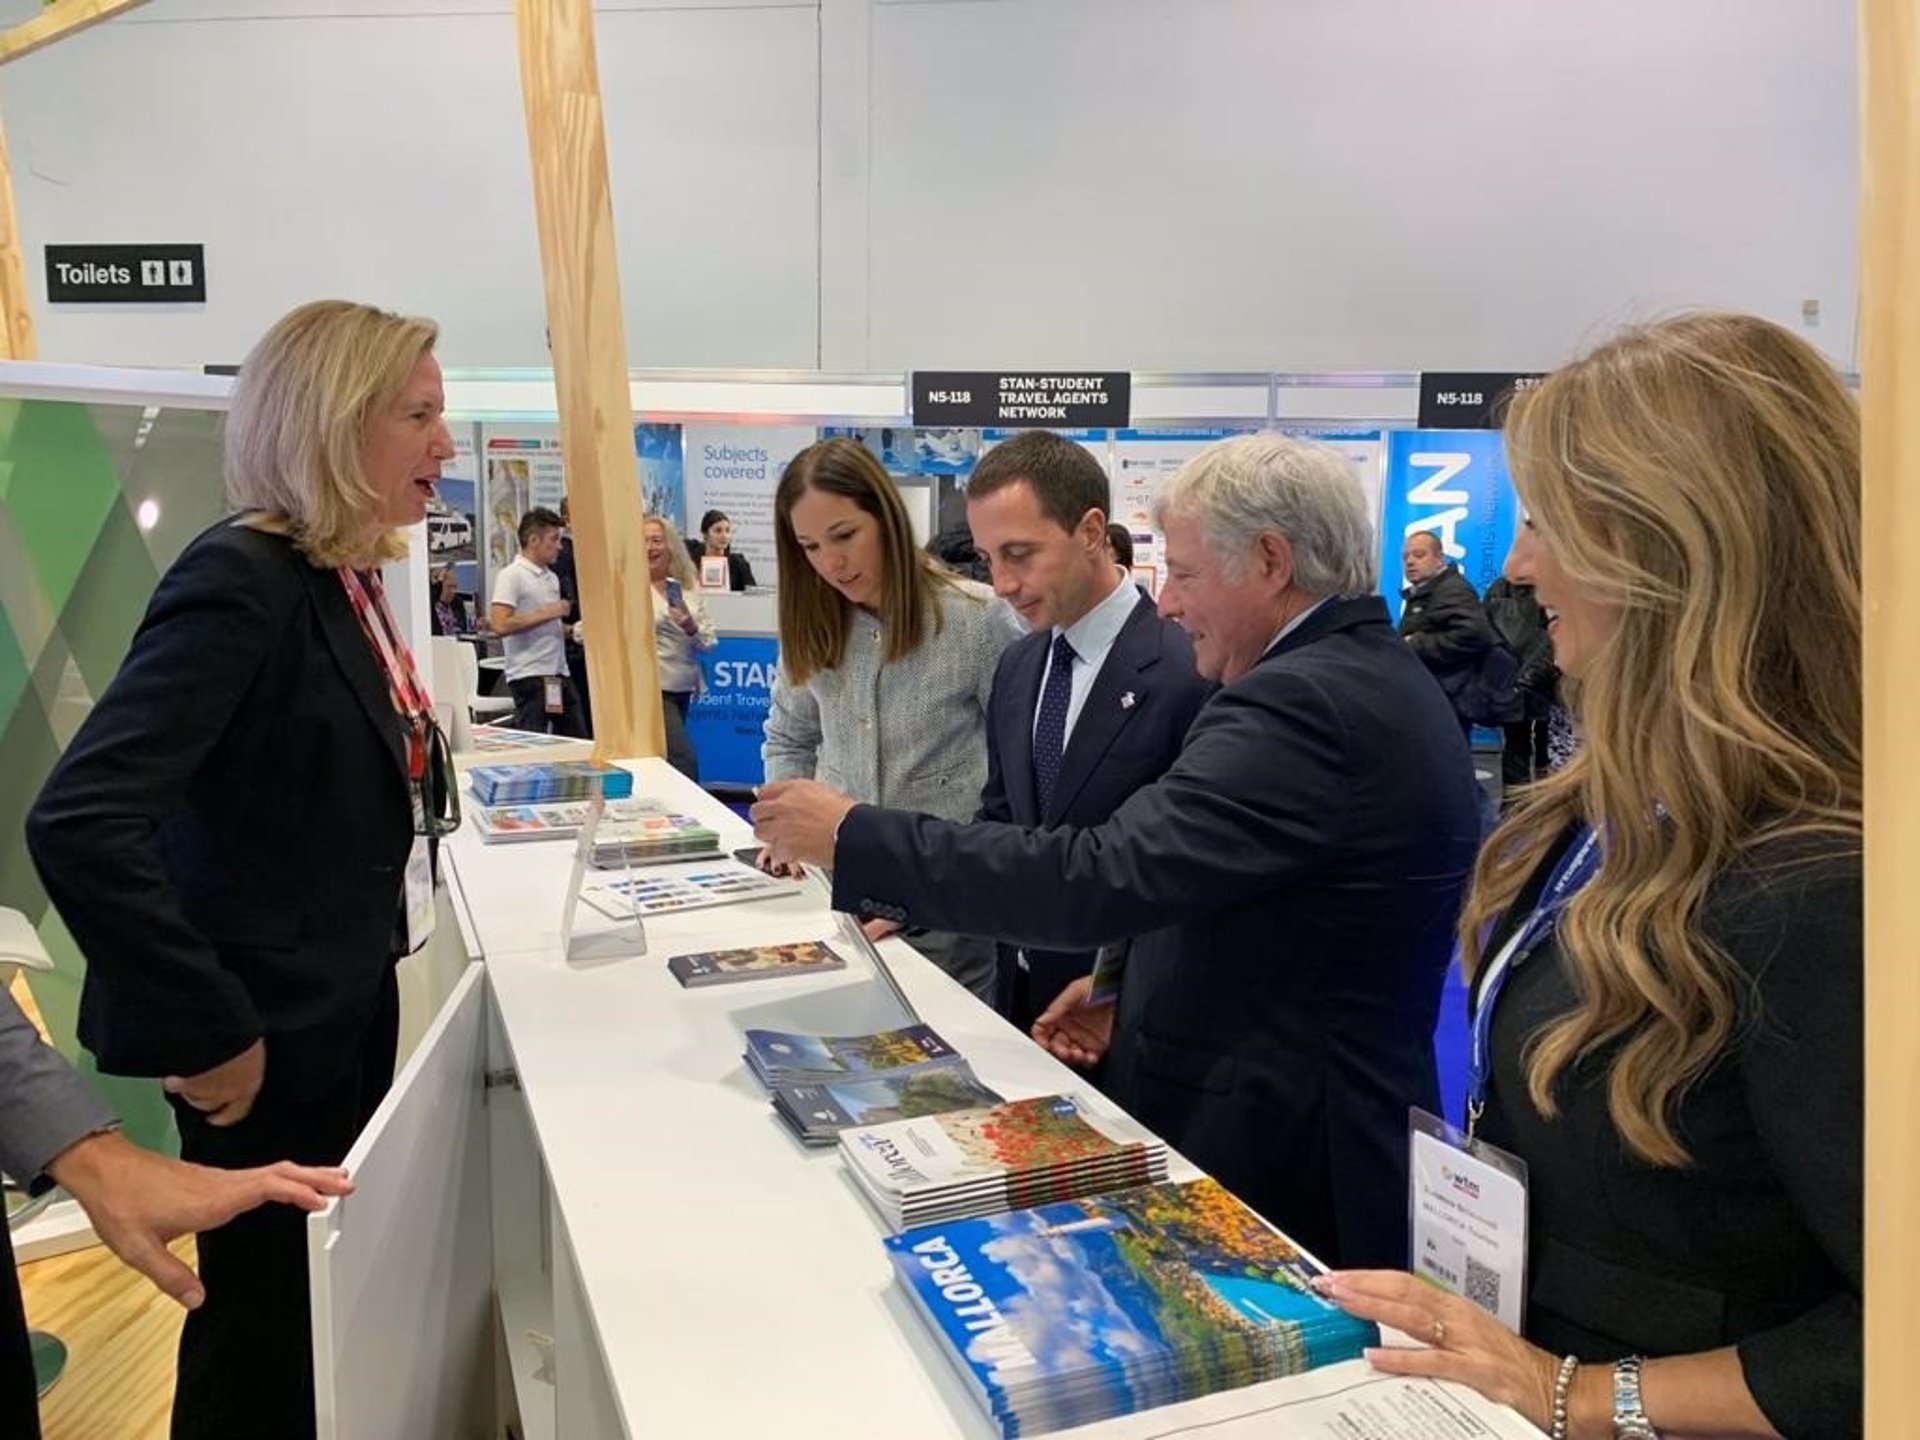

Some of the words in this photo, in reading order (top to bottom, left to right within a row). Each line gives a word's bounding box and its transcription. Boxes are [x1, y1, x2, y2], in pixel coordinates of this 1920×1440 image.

[55, 263, 131, 285] Toilets
[999, 378, 1105, 391] STAN-STUDENT
[928, 391, 972, 404] N5-118
[999, 392, 1052, 405] TRAVEL
[1052, 392, 1109, 405] AGENTS
[1436, 392, 1484, 405] N5-118
[999, 406, 1068, 420] NETWORK
[703, 444, 769, 465] Subjects
[703, 464, 767, 480] covered
[734, 692, 771, 708] Trave
[911, 1235, 1038, 1388] MALLORCA
